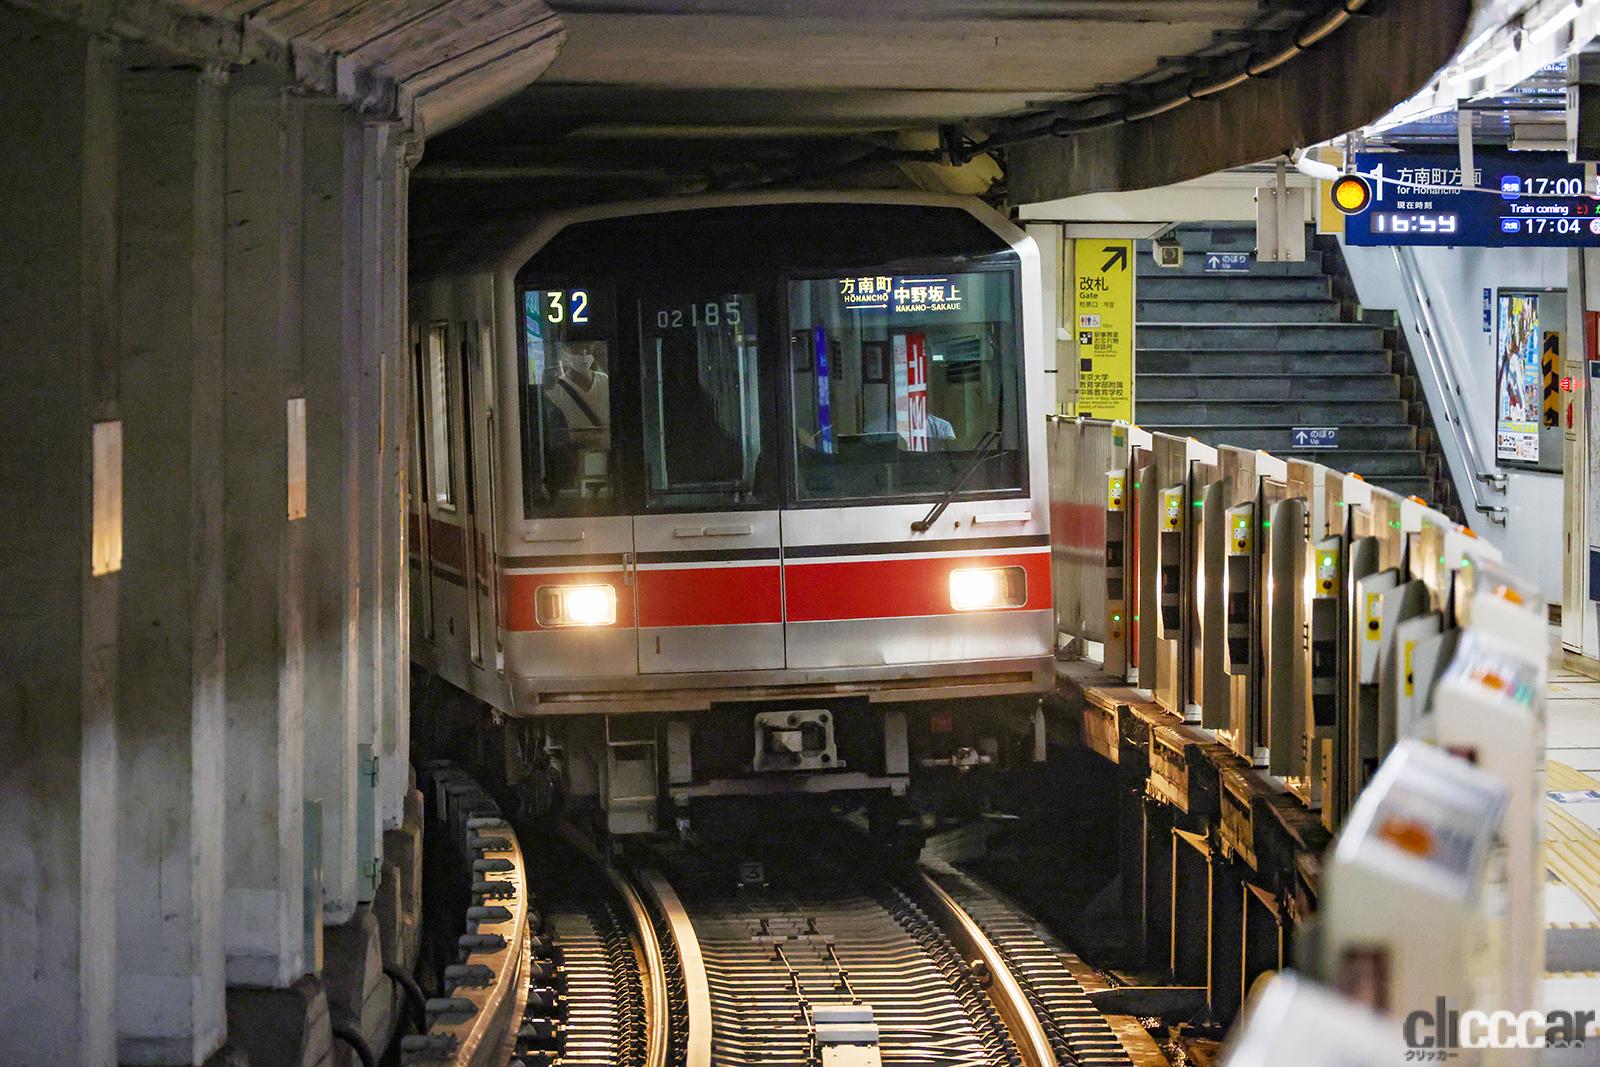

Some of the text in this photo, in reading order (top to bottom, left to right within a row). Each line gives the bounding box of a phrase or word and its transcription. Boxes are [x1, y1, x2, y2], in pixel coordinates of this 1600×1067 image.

[1524, 178, 1582, 196] 17:00
[1397, 201, 1432, 209] 現在時刻
[1510, 204, 1534, 213] Train
[1536, 204, 1569, 215] coming
[1379, 215, 1455, 232] 16:59
[1526, 219, 1581, 234] 17:04
[1222, 255, 1246, 264] のぼり
[840, 276, 893, 294] 方南町
[1080, 277, 1109, 291] 改札
[894, 285, 962, 304] 中野坂上
[896, 303, 961, 312] NAKANO-SAKAUE
[1310, 430, 1335, 439] のぼり
